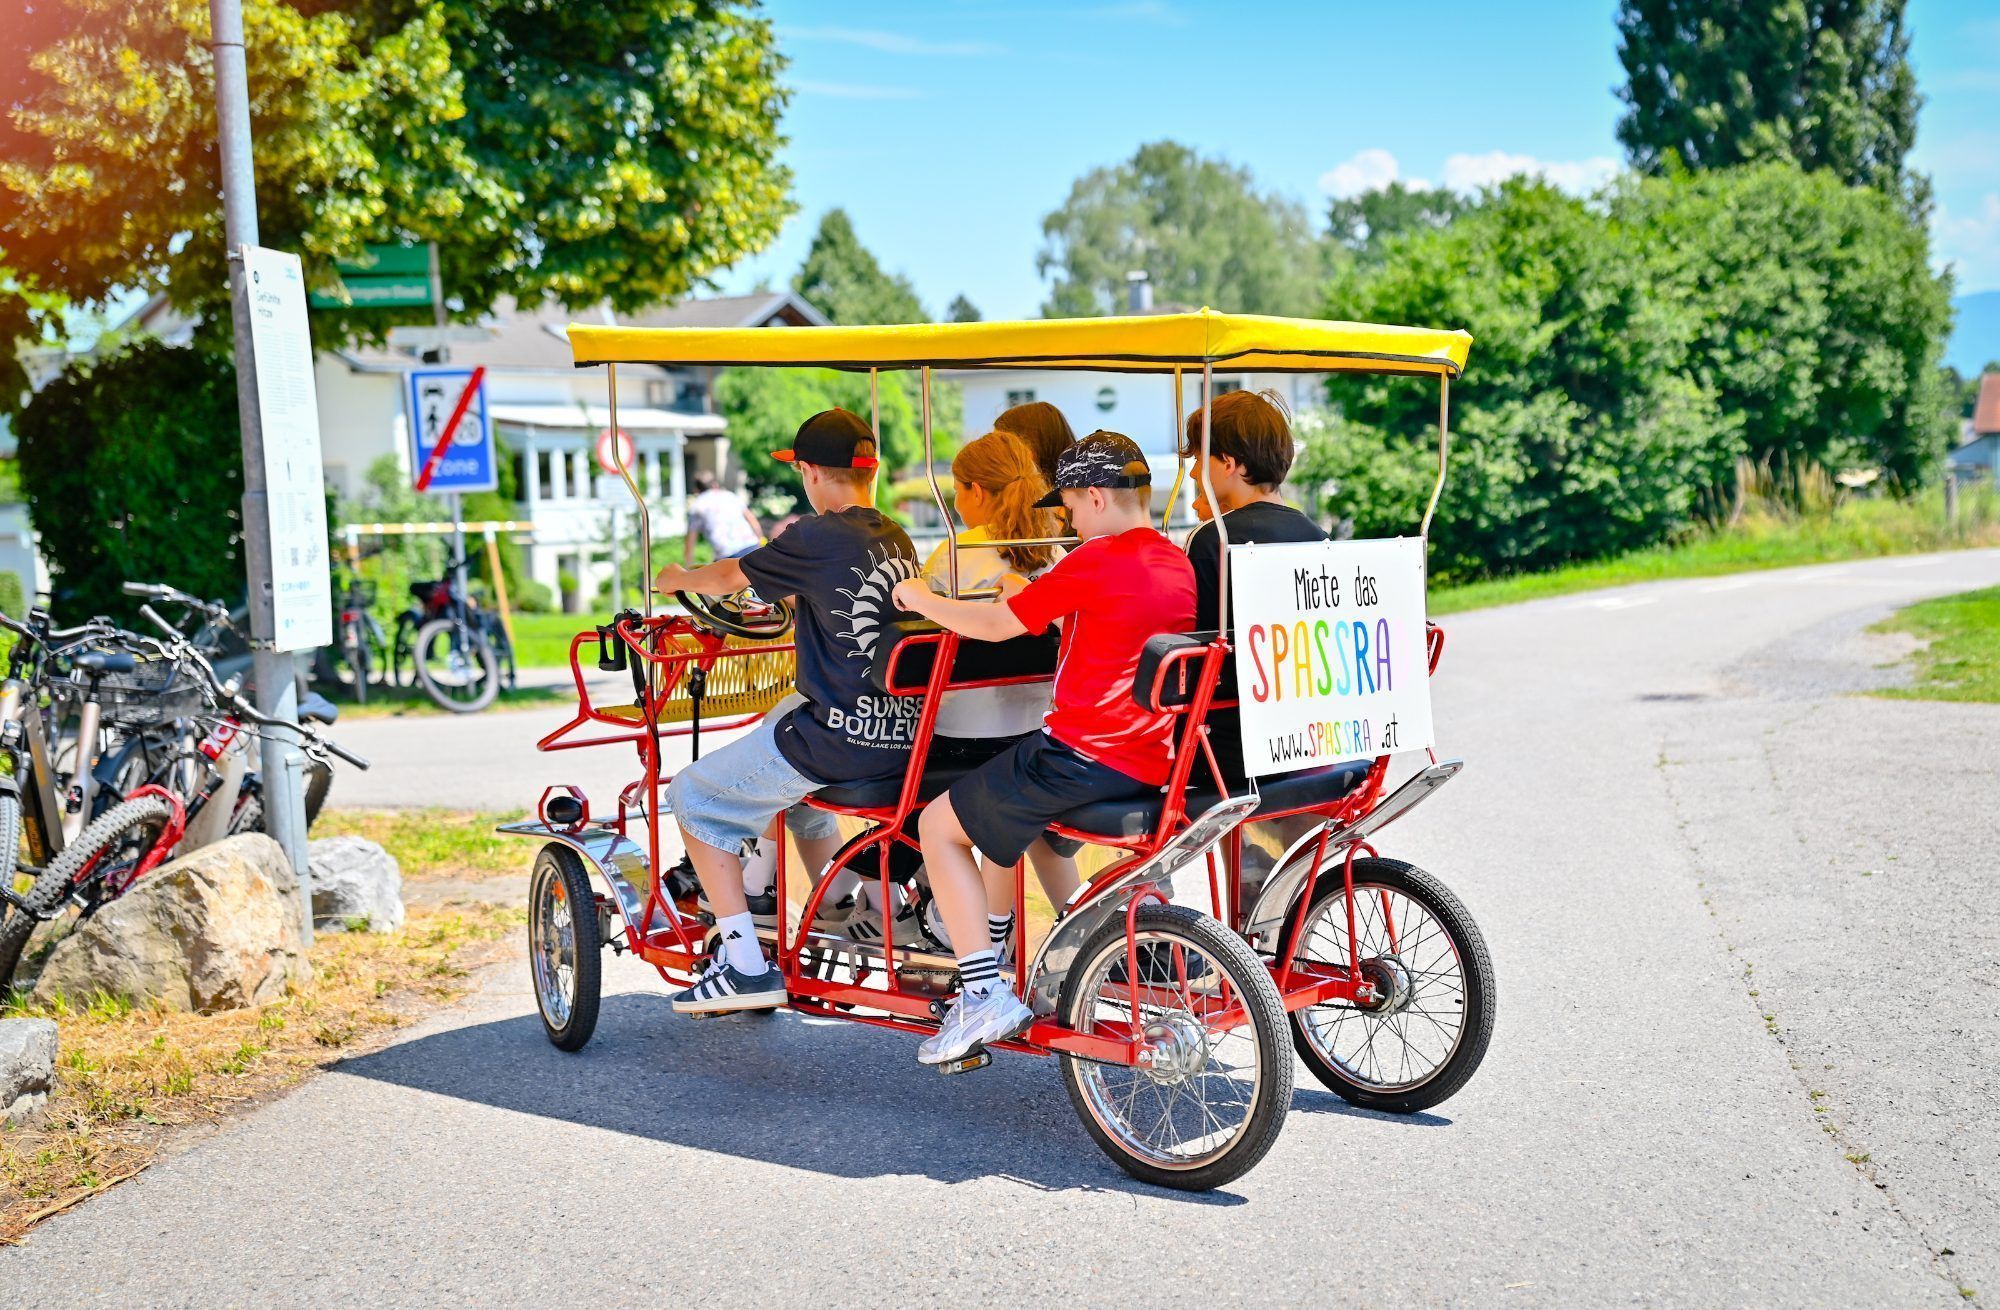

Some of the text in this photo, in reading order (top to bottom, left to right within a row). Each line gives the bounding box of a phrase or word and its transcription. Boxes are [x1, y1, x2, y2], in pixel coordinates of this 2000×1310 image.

[430, 455, 480, 477] Zone
[1294, 563, 1378, 610] Miete das
[1249, 618, 1393, 702] SPASSRA
[855, 695, 924, 719] SUNSE
[827, 707, 918, 741] BOULEV
[846, 737, 871, 747] SILVER
[871, 742, 889, 750] LAKE
